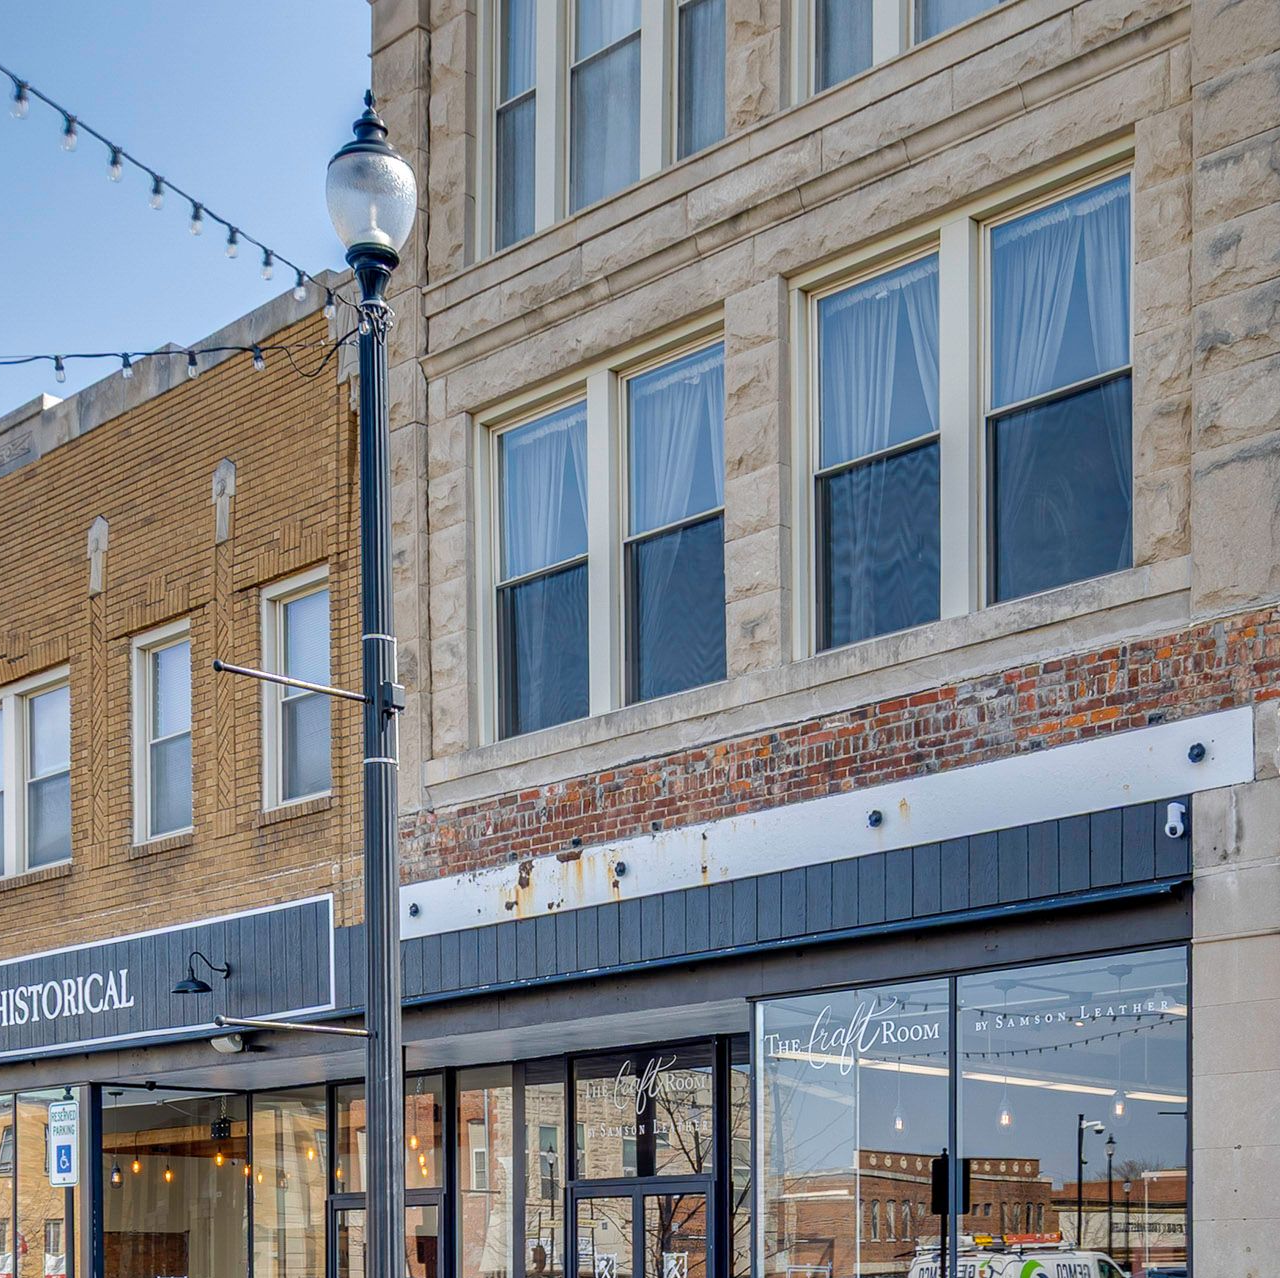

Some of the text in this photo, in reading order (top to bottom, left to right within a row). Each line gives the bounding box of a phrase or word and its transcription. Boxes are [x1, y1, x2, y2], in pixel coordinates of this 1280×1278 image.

[995, 1012, 1067, 1029] SAMSON
[1080, 1000, 1169, 1020] LEATHER
[764, 996, 940, 1075] THE Craft ROOM
[585, 1081, 609, 1099] THE
[665, 1073, 706, 1091] ROOM
[51, 1110, 76, 1121] RESERVED
[52, 1124, 75, 1136] PARKING
[600, 1122, 646, 1137] SAMSON
[653, 1119, 708, 1134] LEATHER
